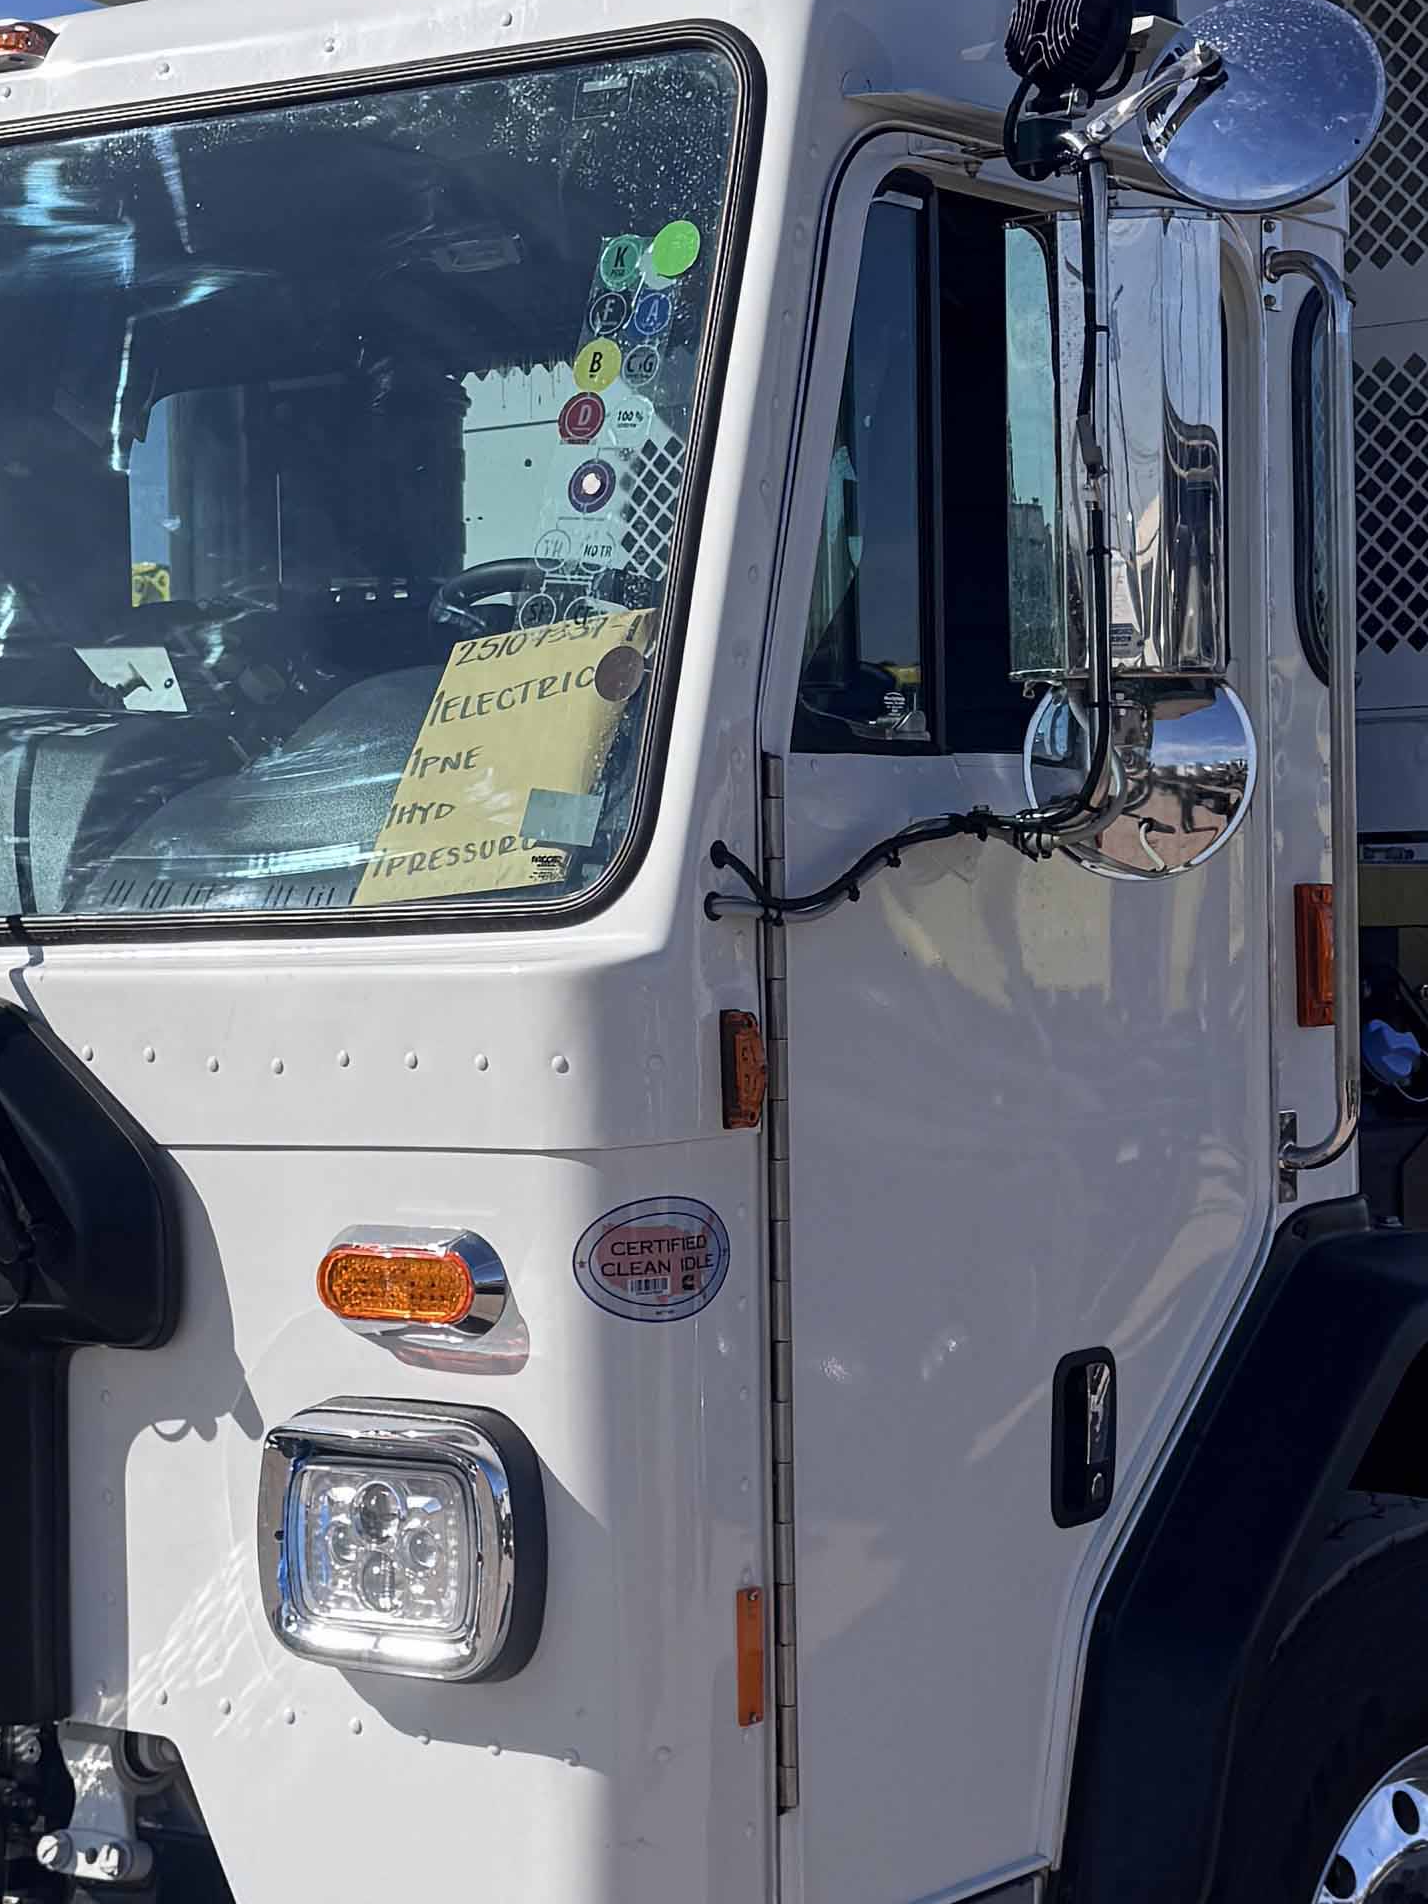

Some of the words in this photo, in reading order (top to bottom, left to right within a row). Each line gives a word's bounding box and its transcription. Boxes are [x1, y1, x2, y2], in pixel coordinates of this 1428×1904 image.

[614, 246, 628, 268] K
[646, 299, 660, 322] A
[589, 352, 602, 374] B
[578, 404, 591, 426] D
[610, 1234, 707, 1256] CERTIFIED
[601, 1257, 671, 1277] CLEAN
[680, 1253, 714, 1273] IDLE
